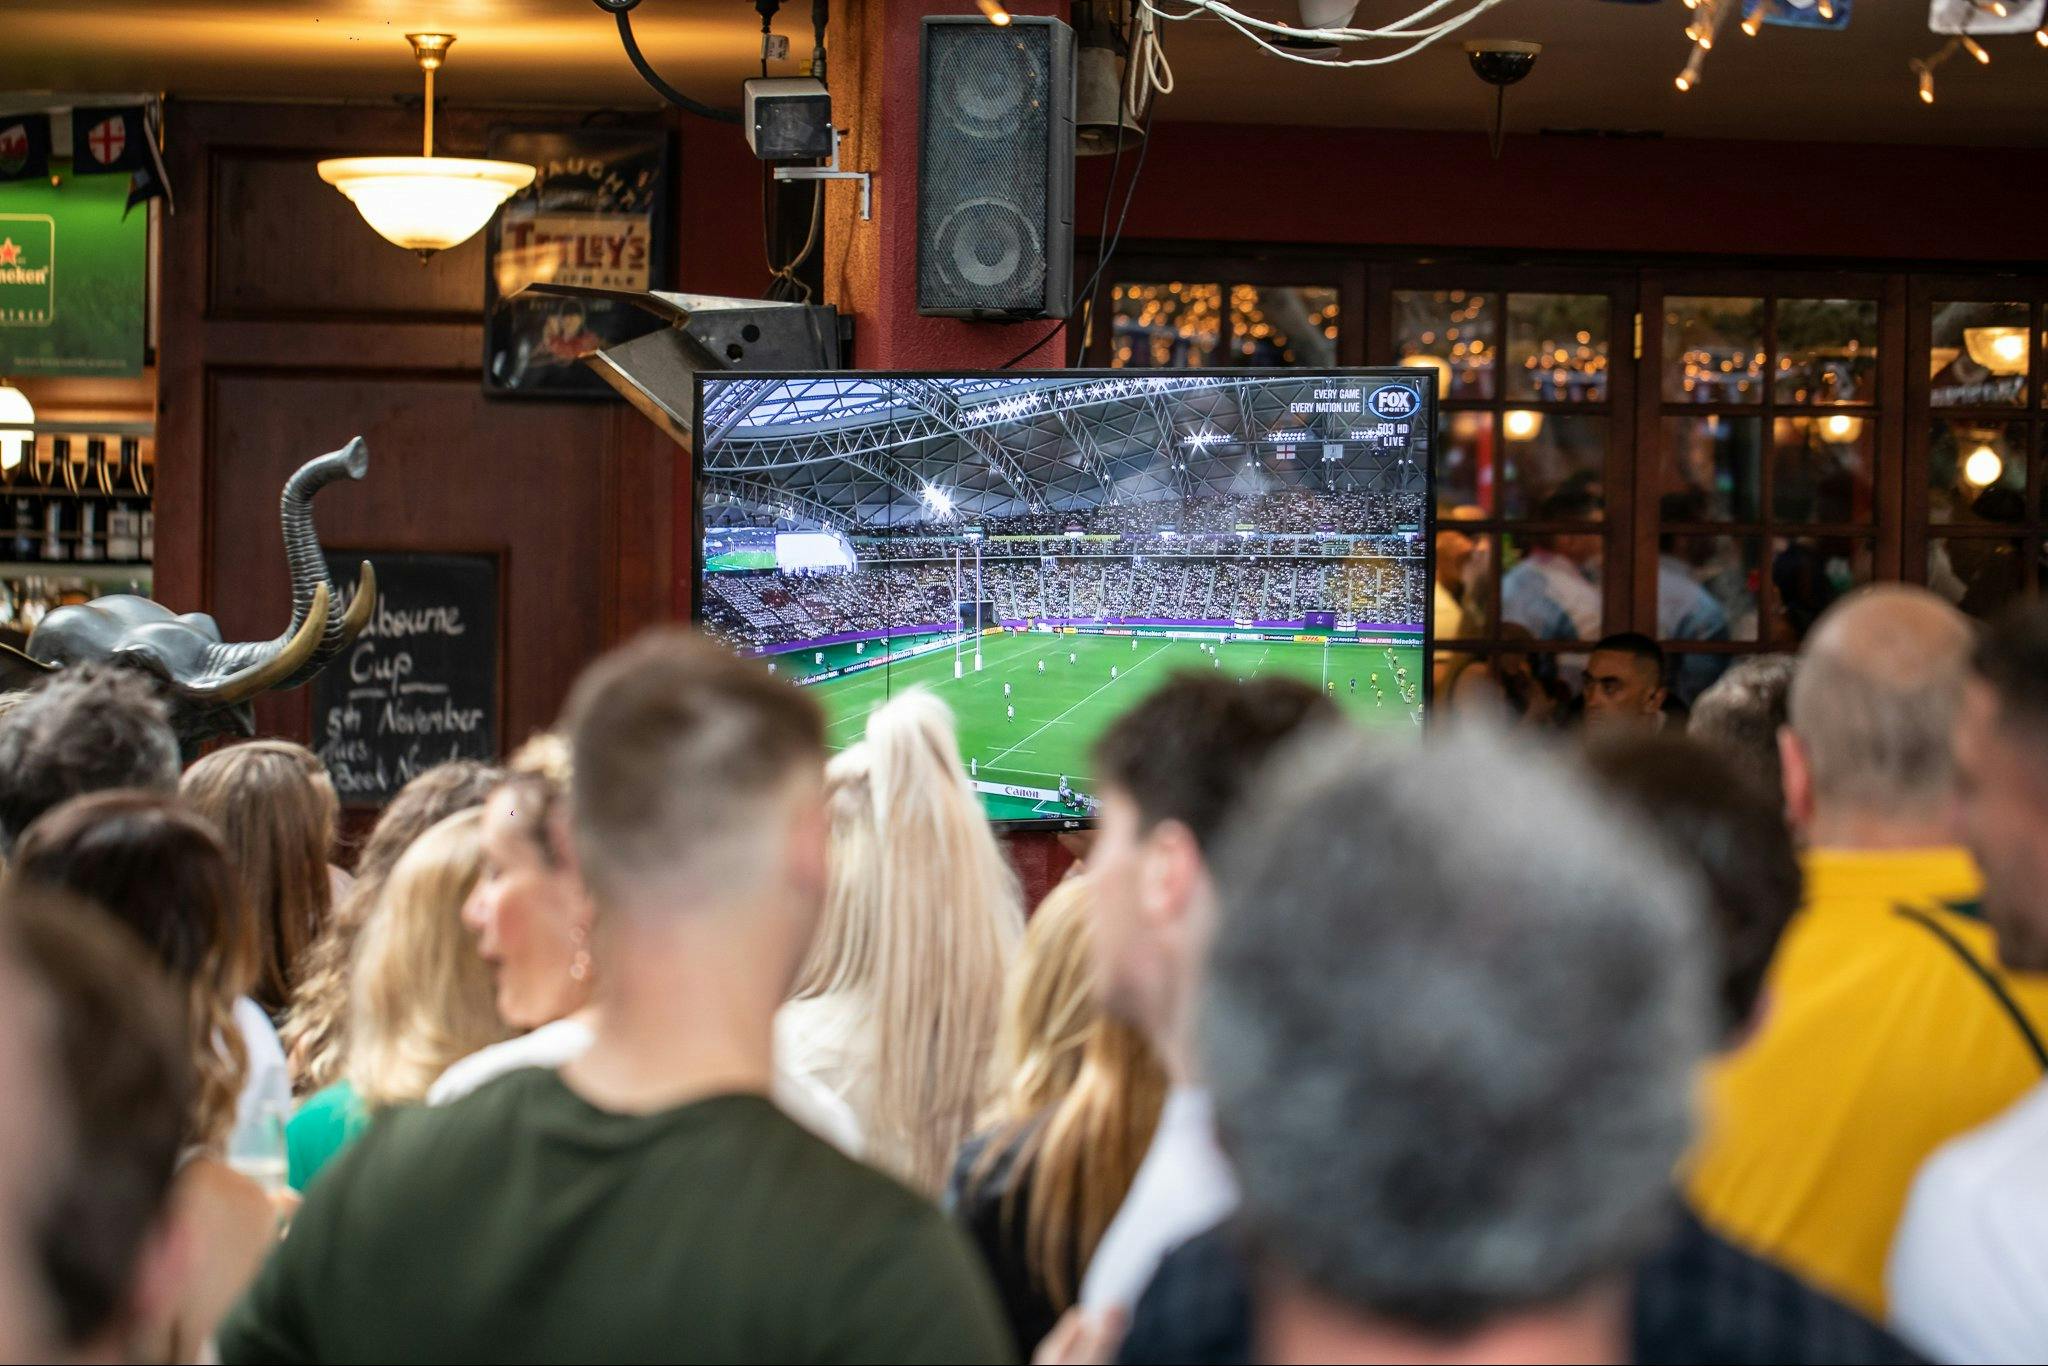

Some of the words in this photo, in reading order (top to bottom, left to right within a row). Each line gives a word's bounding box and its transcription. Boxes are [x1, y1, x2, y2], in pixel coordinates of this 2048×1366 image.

[1313, 389, 1337, 399] EVERY
[1340, 389, 1360, 399] GAME
[1378, 391, 1411, 407] FOX
[1290, 402, 1314, 413] EVERY
[1316, 402, 1342, 413] NATION
[1344, 402, 1360, 413] LIVE
[1397, 423, 1409, 434] HD
[1383, 437, 1405, 447] LIVE
[350, 641, 413, 697] Cup
[1005, 786, 1039, 799] Canon
